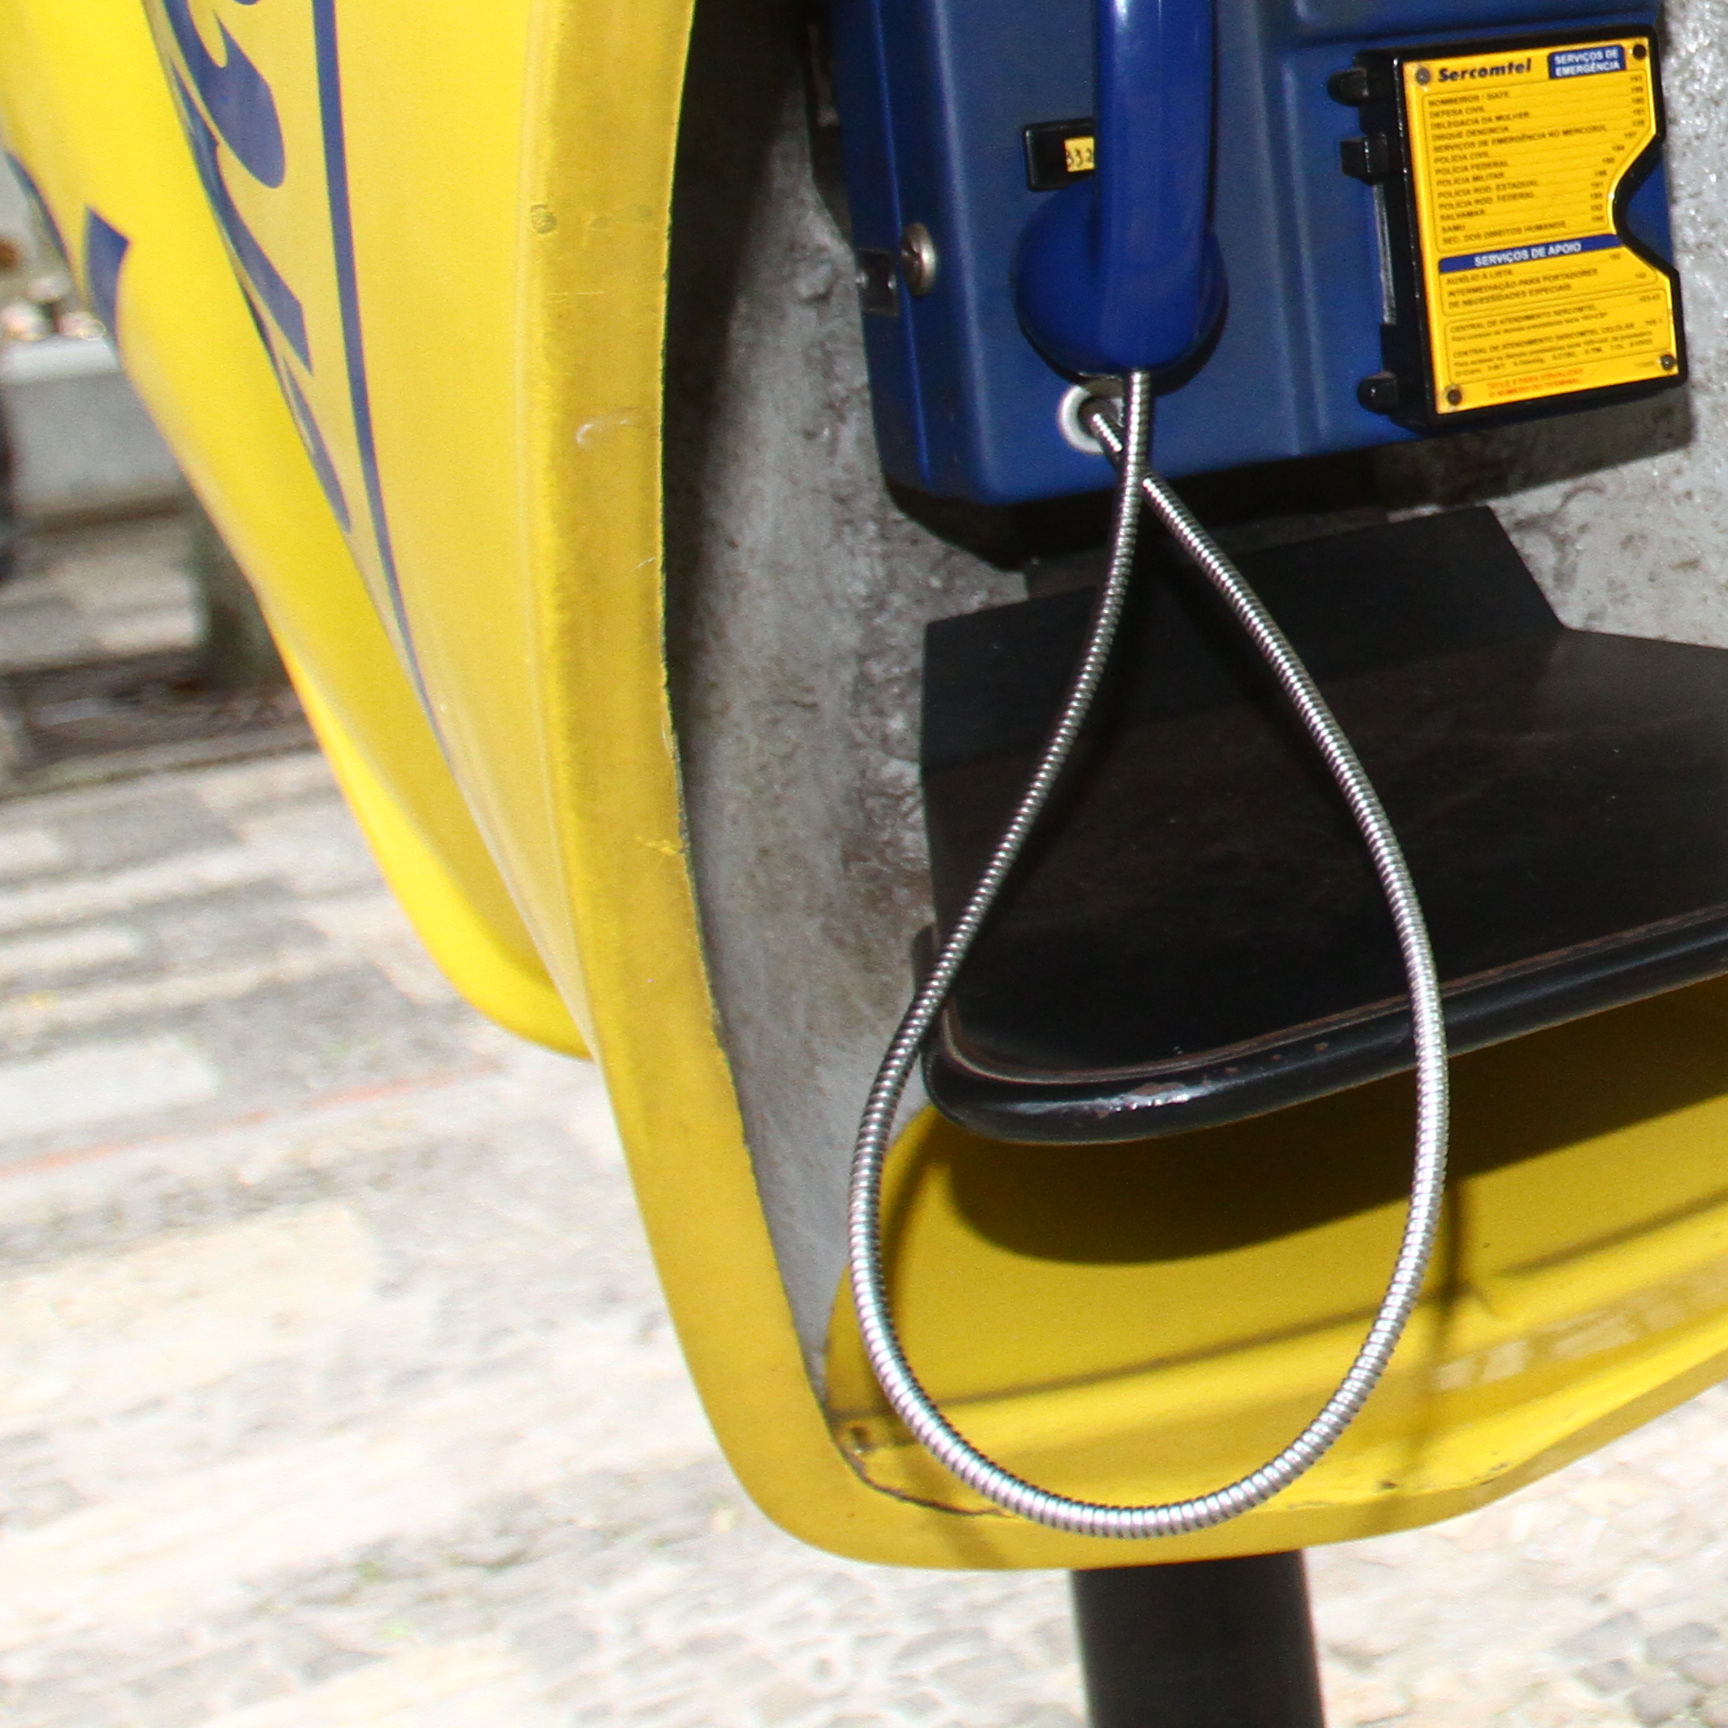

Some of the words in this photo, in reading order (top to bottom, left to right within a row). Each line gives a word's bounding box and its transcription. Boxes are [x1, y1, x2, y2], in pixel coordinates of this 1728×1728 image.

[1554, 50, 1603, 64] SERVIÇOS
[1604, 48, 1618, 58] DE
[1437, 58, 1532, 82] Sercomtel
[1555, 59, 1620, 76] EMERGÊNCIA
[1474, 249, 1528, 266] SERVIÇOS
[1530, 247, 1545, 258] DE
[1547, 241, 1581, 255] APOIO
